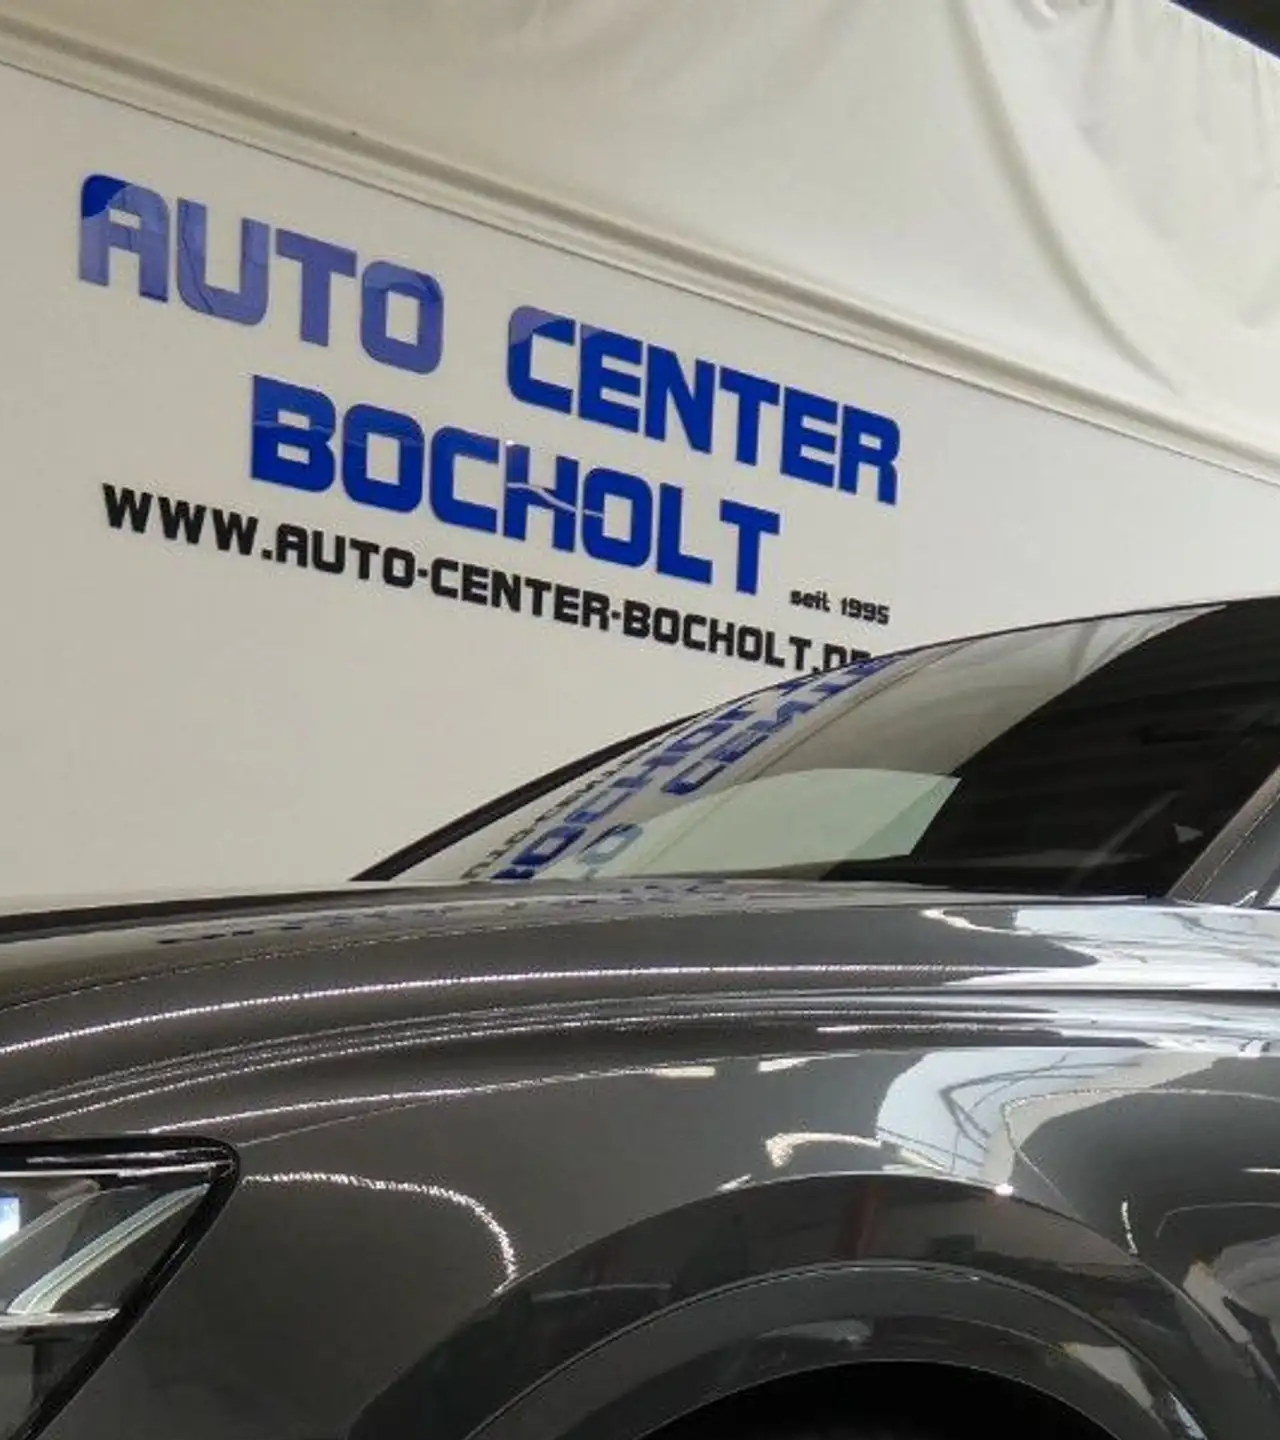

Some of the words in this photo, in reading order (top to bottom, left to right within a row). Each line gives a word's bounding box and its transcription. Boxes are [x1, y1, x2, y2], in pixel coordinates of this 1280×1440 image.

[80, 173, 444, 375] AUTO
[506, 304, 902, 506] CENTER
[249, 374, 782, 596] BOCHOLT
[789, 588, 831, 613] seit
[840, 596, 890, 626] 1995
